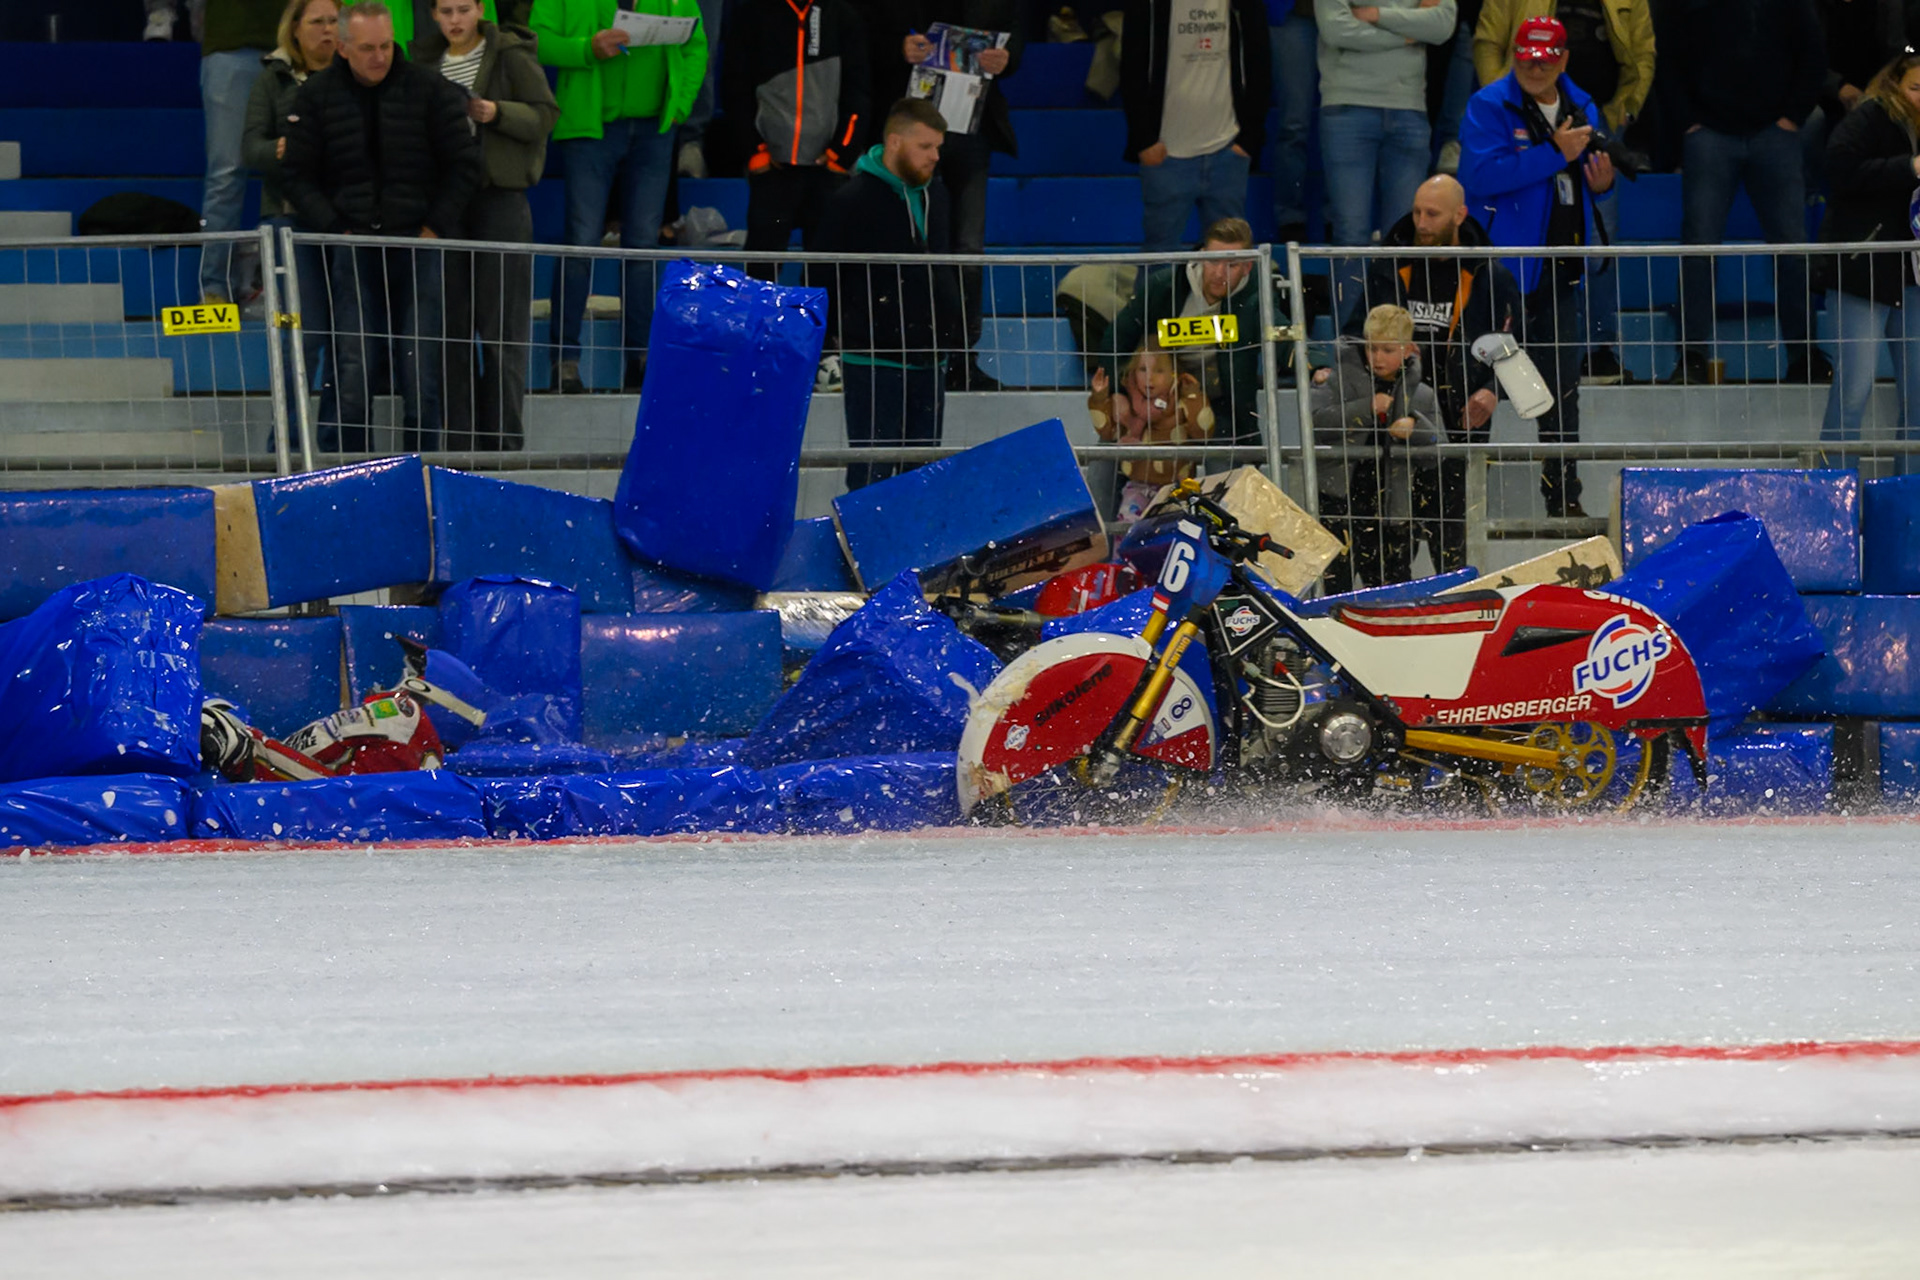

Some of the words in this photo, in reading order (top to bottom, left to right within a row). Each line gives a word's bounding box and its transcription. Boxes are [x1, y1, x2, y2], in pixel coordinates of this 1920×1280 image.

[170, 307, 232, 326] D.E.V.
[1167, 318, 1230, 338] D.E.V.
[1226, 616, 1260, 626] FUCHS
[1576, 633, 1668, 690] FUCHS
[1437, 694, 1593, 724] EHRENSBERGER
